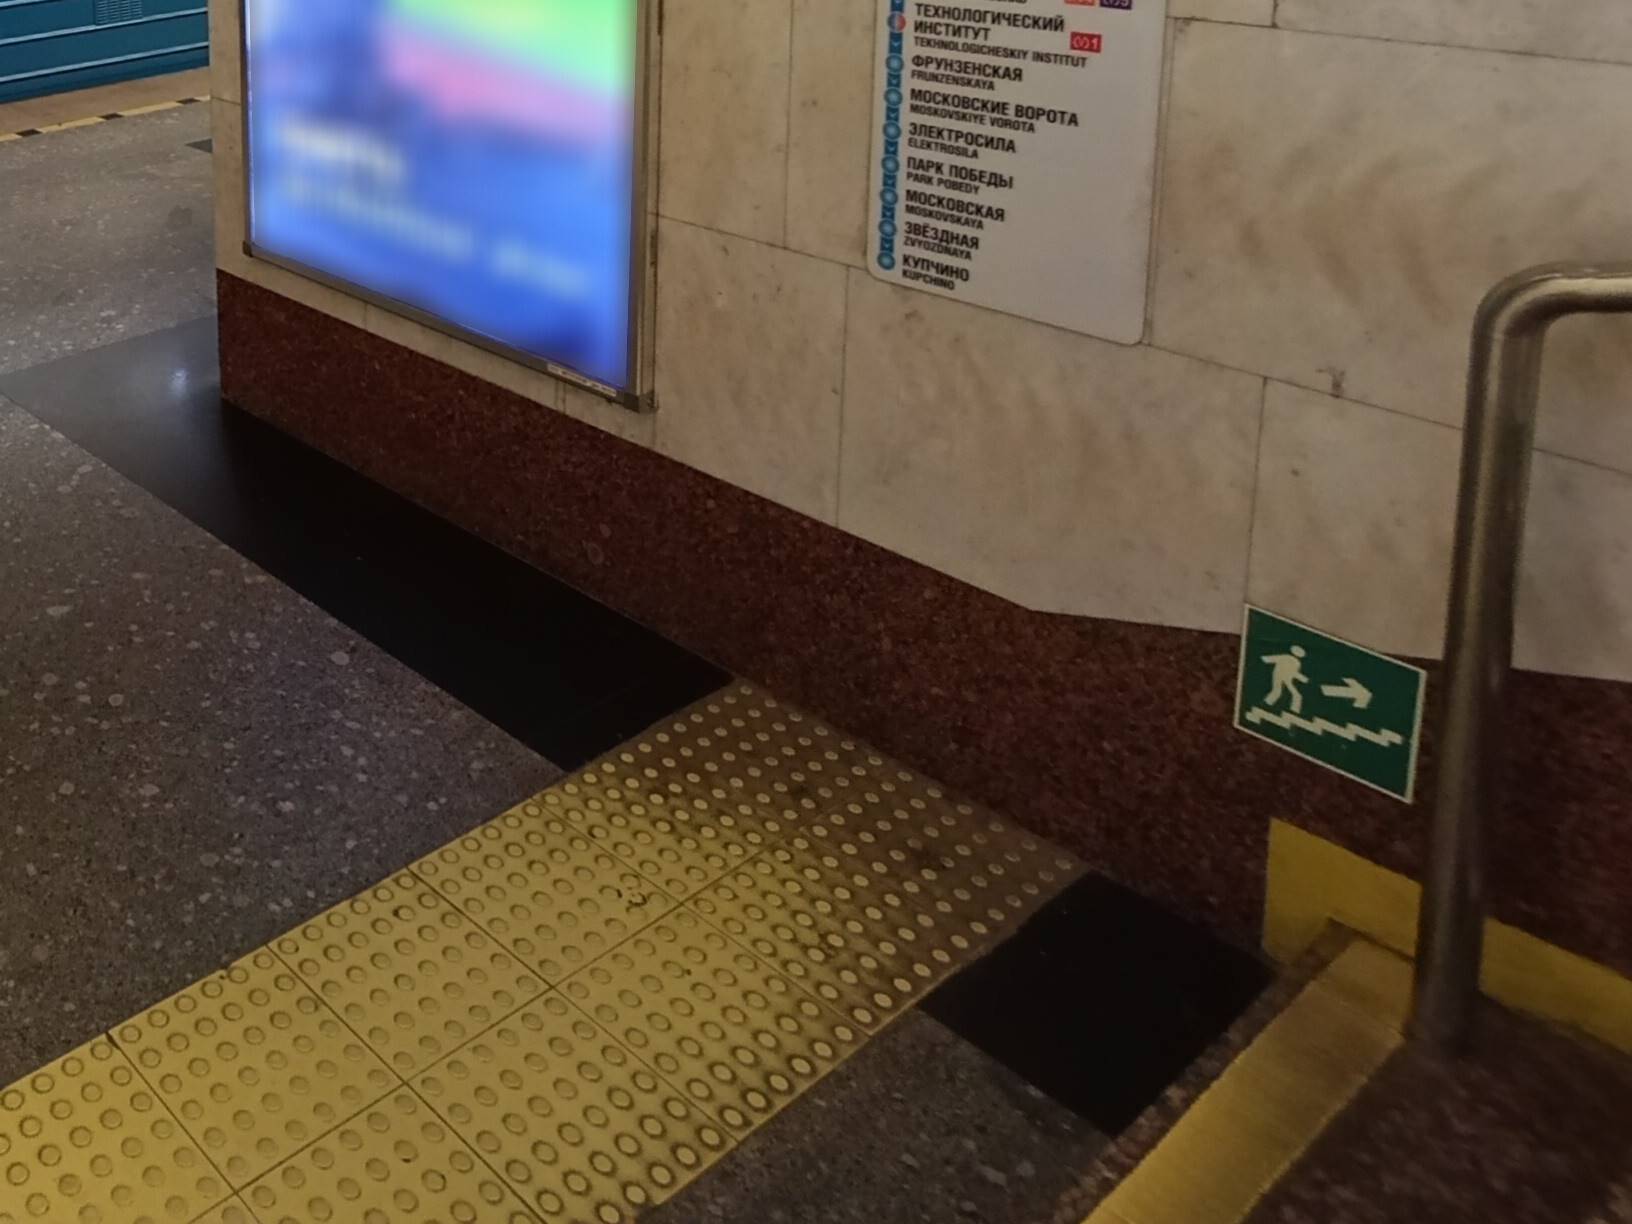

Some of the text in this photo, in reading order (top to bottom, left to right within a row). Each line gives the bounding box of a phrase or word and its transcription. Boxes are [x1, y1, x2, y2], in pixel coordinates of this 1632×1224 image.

[914, 21, 991, 41] ИНСТИТУТ
[915, 4, 1065, 32] ТЕХНОЛОГИЧЕСКИЙ
[913, 36, 1088, 68] TEKHNOLOGICHESKIY INSTITUT
[911, 69, 995, 91] FRUNZENSKAYA
[912, 55, 1023, 82] ФРУНЗЕНСКАЯ
[909, 103, 1035, 133] MOSKOVSKIYE VOROTA
[910, 89, 1079, 127] МОСКОВСКИЕ ВОРОТА
[908, 137, 979, 159] ELEKTROSILA
[909, 122, 1016, 153] ЭЛЕКТРОСИЛА
[906, 171, 980, 195] PARK POBEDY
[907, 156, 1014, 189] ПАРК ПОБЕДЫ
[905, 204, 984, 230] MOSKOVSKAYA
[906, 189, 1005, 222] МОСКОВСКАЯ
[904, 221, 980, 250] ЗВЁЗДНАЯ
[904, 236, 972, 261] ZVYOZDNAYA
[902, 254, 970, 282] КУПЧИНО
[902, 268, 956, 290] KUPCHINO
